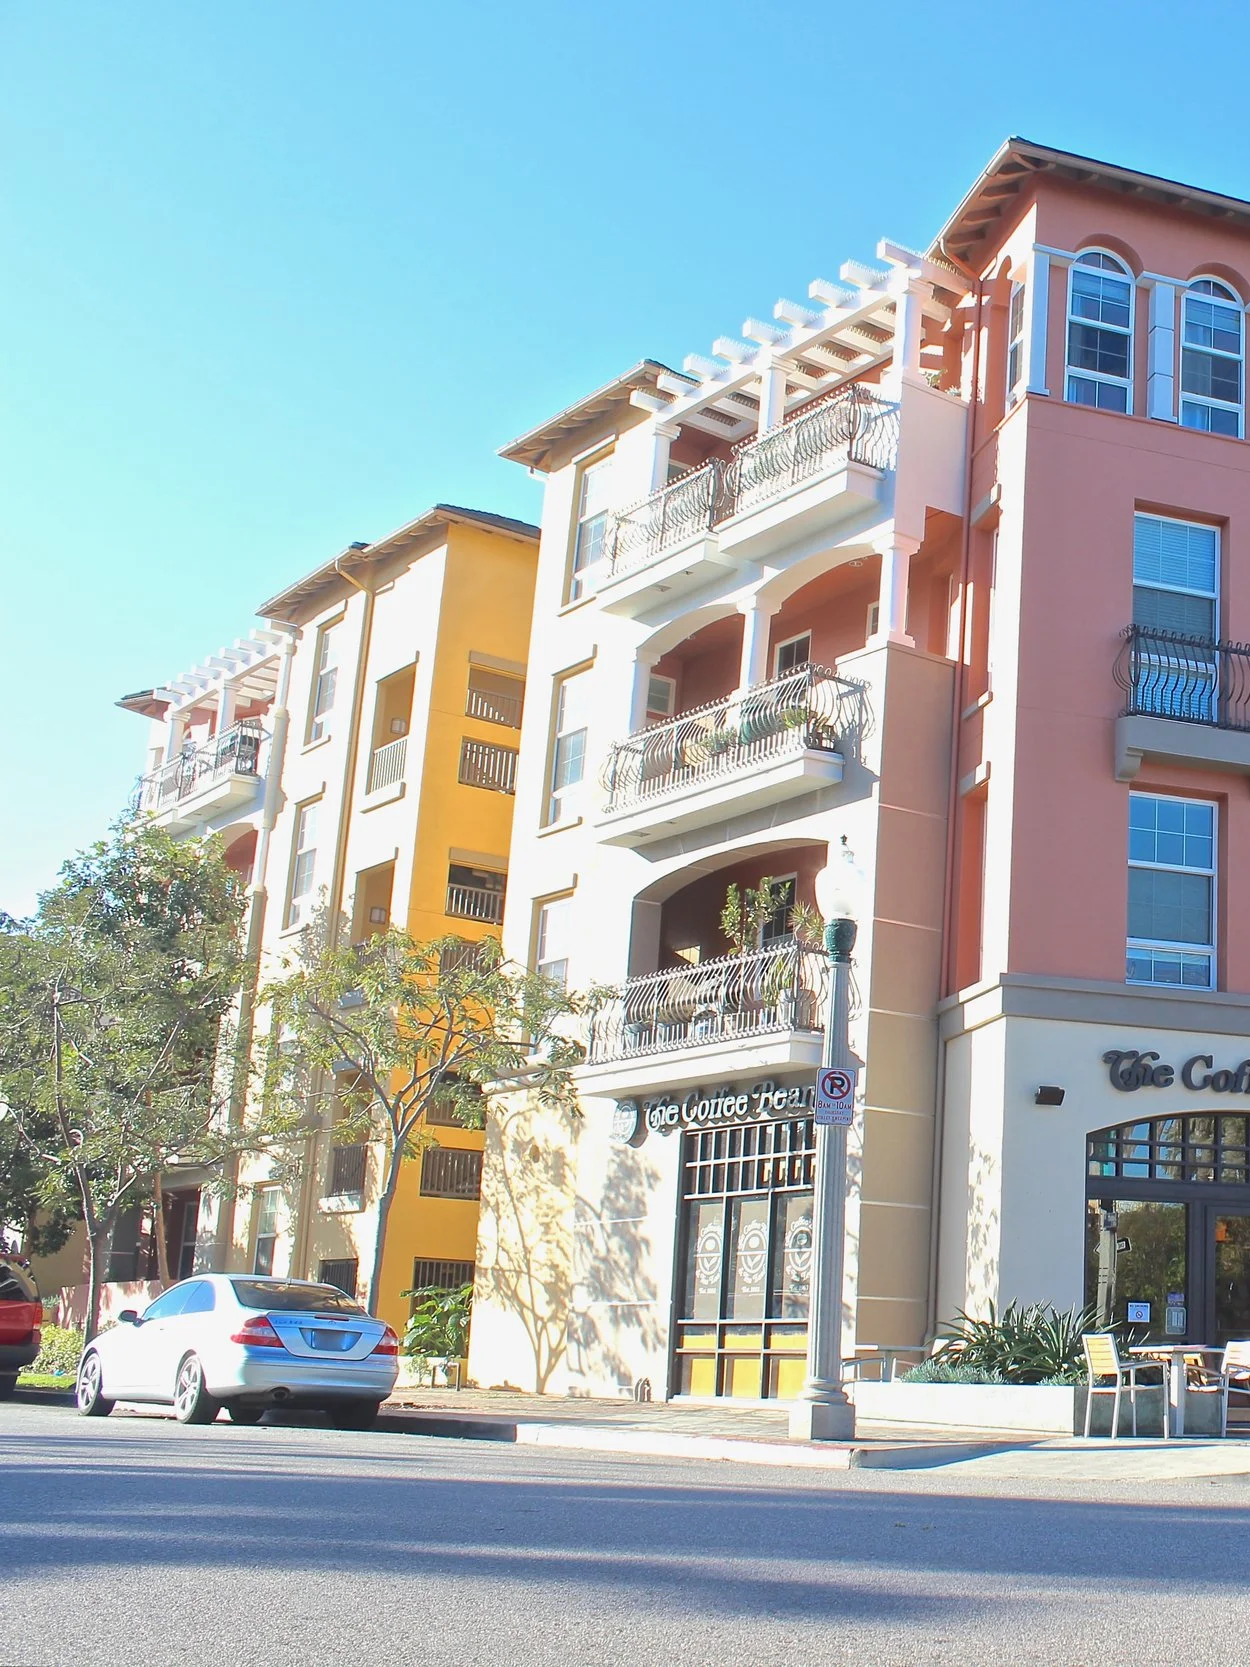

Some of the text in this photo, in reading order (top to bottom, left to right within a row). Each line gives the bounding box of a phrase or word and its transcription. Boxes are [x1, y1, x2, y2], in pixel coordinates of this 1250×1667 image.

[1102, 1050, 1175, 1092] The
[644, 1095, 680, 1131] The
[682, 1086, 748, 1124] Coffee
[752, 1080, 816, 1114] Bean
